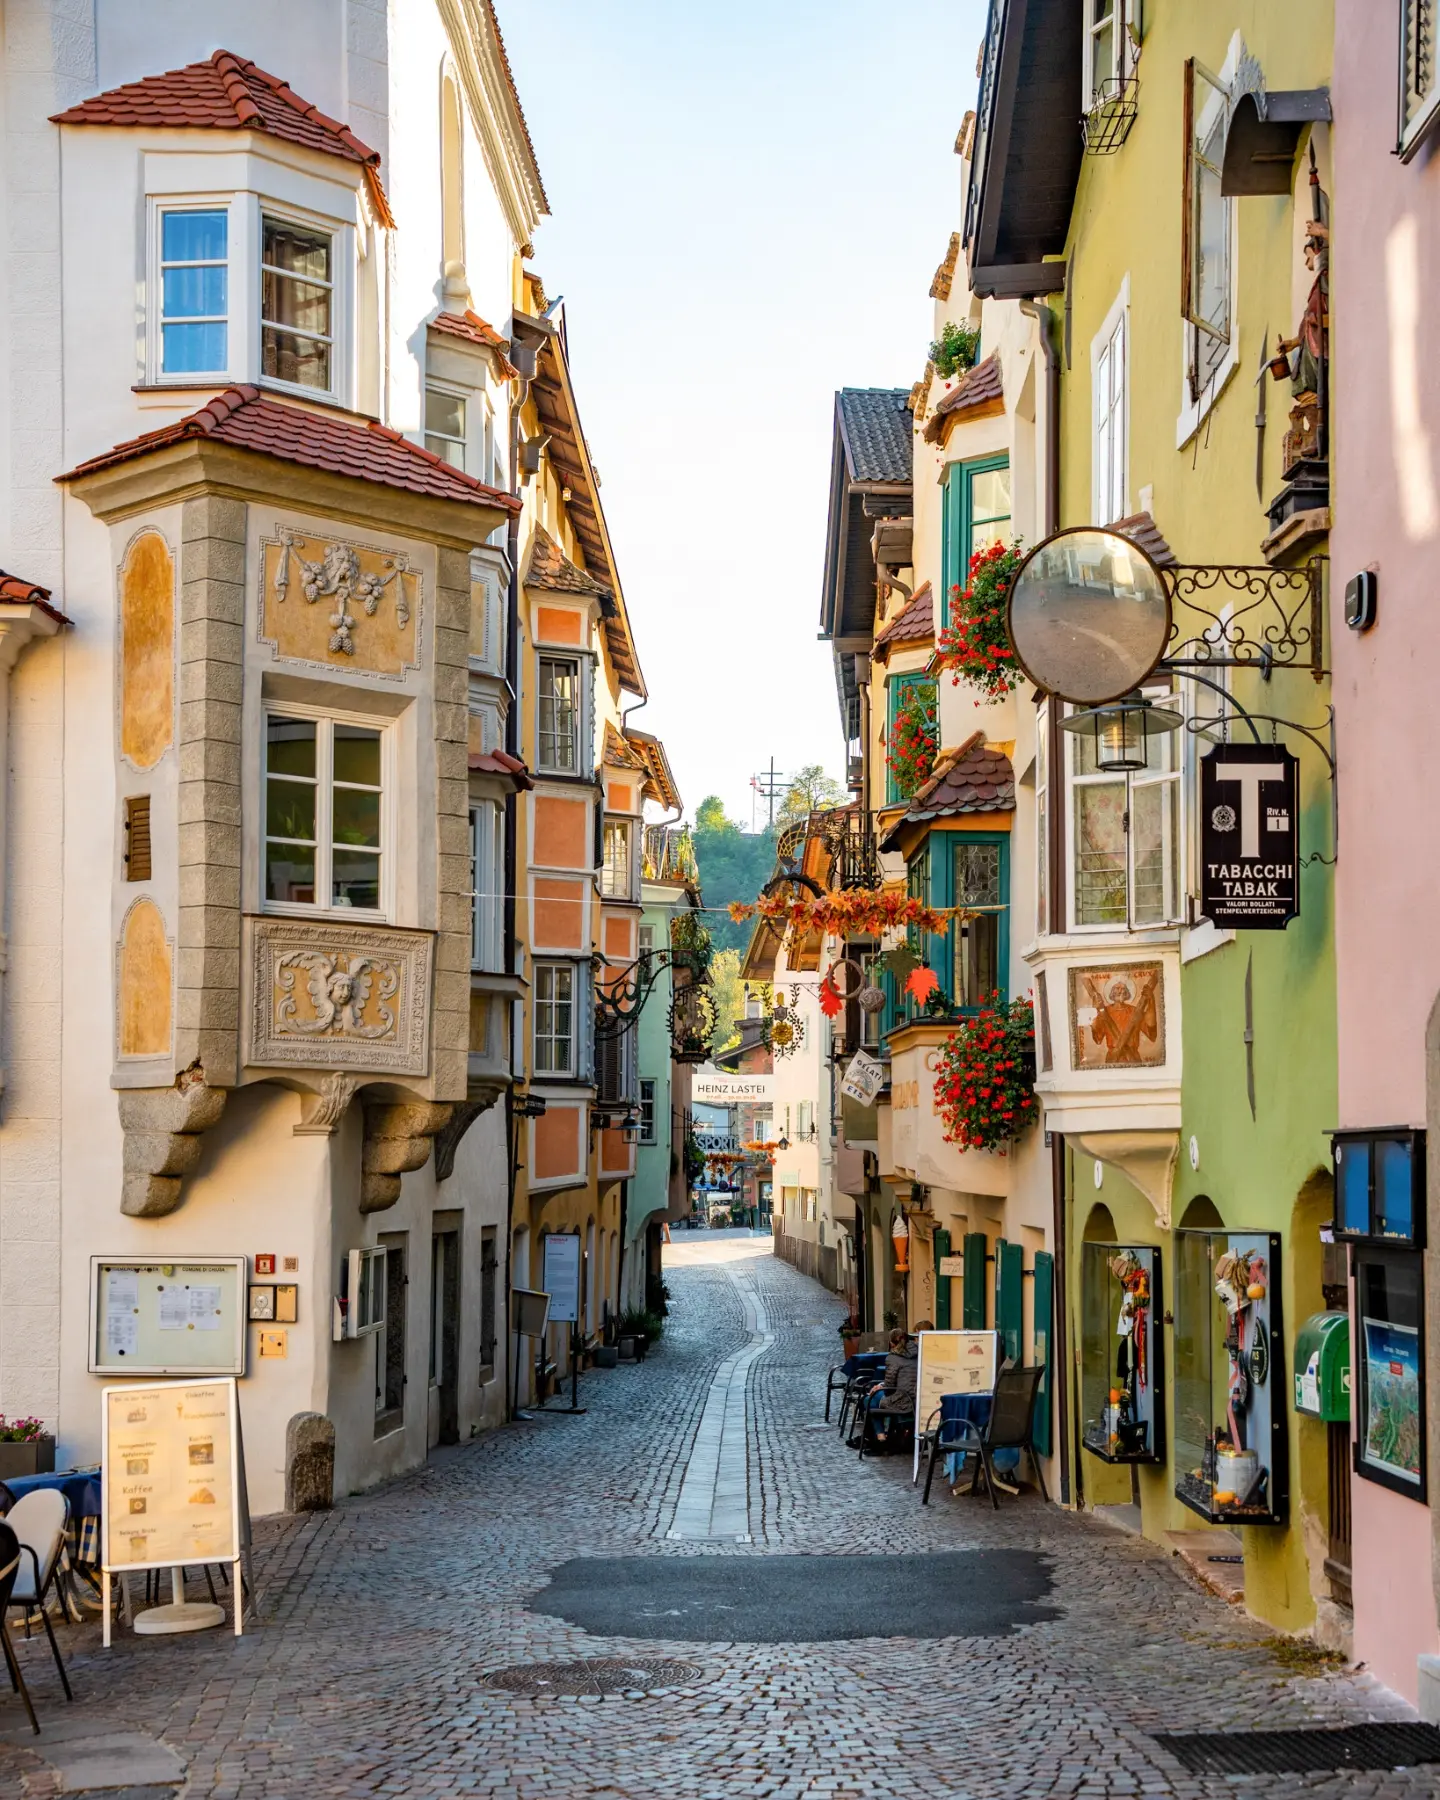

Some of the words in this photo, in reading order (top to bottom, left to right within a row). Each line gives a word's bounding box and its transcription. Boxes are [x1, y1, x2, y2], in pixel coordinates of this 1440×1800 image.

[1216, 763, 1284, 857] T
[1208, 864, 1293, 879] TABACCHI
[1223, 882, 1278, 896] TABAK
[857, 1059, 882, 1081] GELATI
[697, 1085, 729, 1093] HEINZ
[731, 1085, 766, 1094] LASTEI
[846, 1085, 864, 1099] EIS
[697, 1136, 734, 1149] SPORT
[122, 1485, 153, 1494] Kaffee
